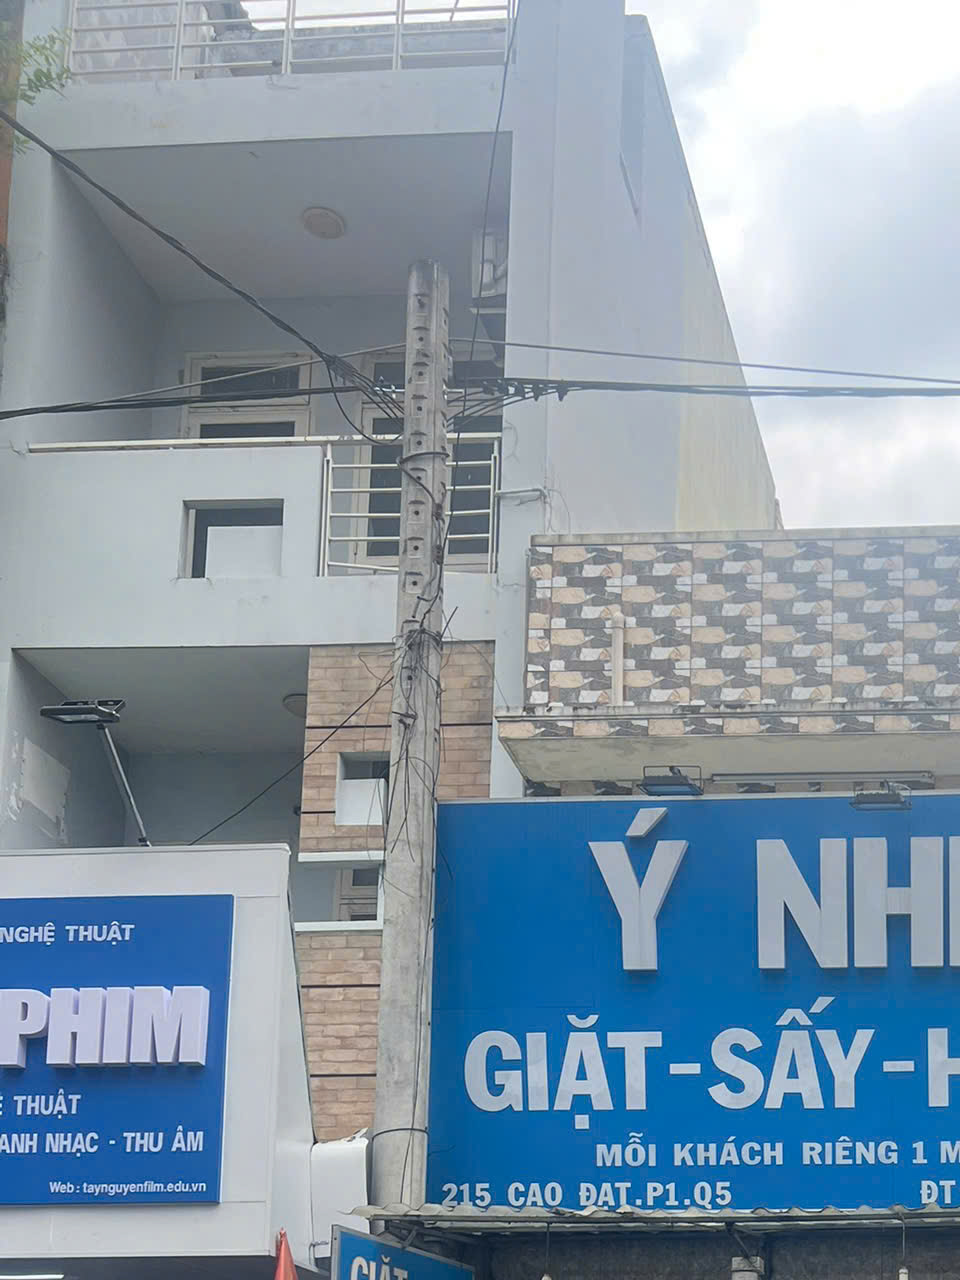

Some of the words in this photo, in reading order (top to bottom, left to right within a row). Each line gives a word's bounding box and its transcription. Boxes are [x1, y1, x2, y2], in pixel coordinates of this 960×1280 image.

[588, 807, 689, 972] Ý
[0, 922, 55, 945] NGHỆ
[65, 921, 135, 945] THUẬT
[0, 986, 210, 1068] PHIM
[14, 1088, 81, 1119] THUẬT
[45, 1132, 99, 1157] NHẠC
[123, 1132, 163, 1153] THU
[172, 1125, 204, 1152] ÂM
[596, 1132, 657, 1167] MỖI
[674, 1136, 783, 1166] KHÁCH
[803, 1137, 898, 1165] RIÊNG
[912, 1141, 928, 1163] 1
[83, 1180, 206, 1196] taynguyenfilm.edu.vn
[441, 1182, 492, 1206] 215
[507, 1181, 563, 1206] CAO
